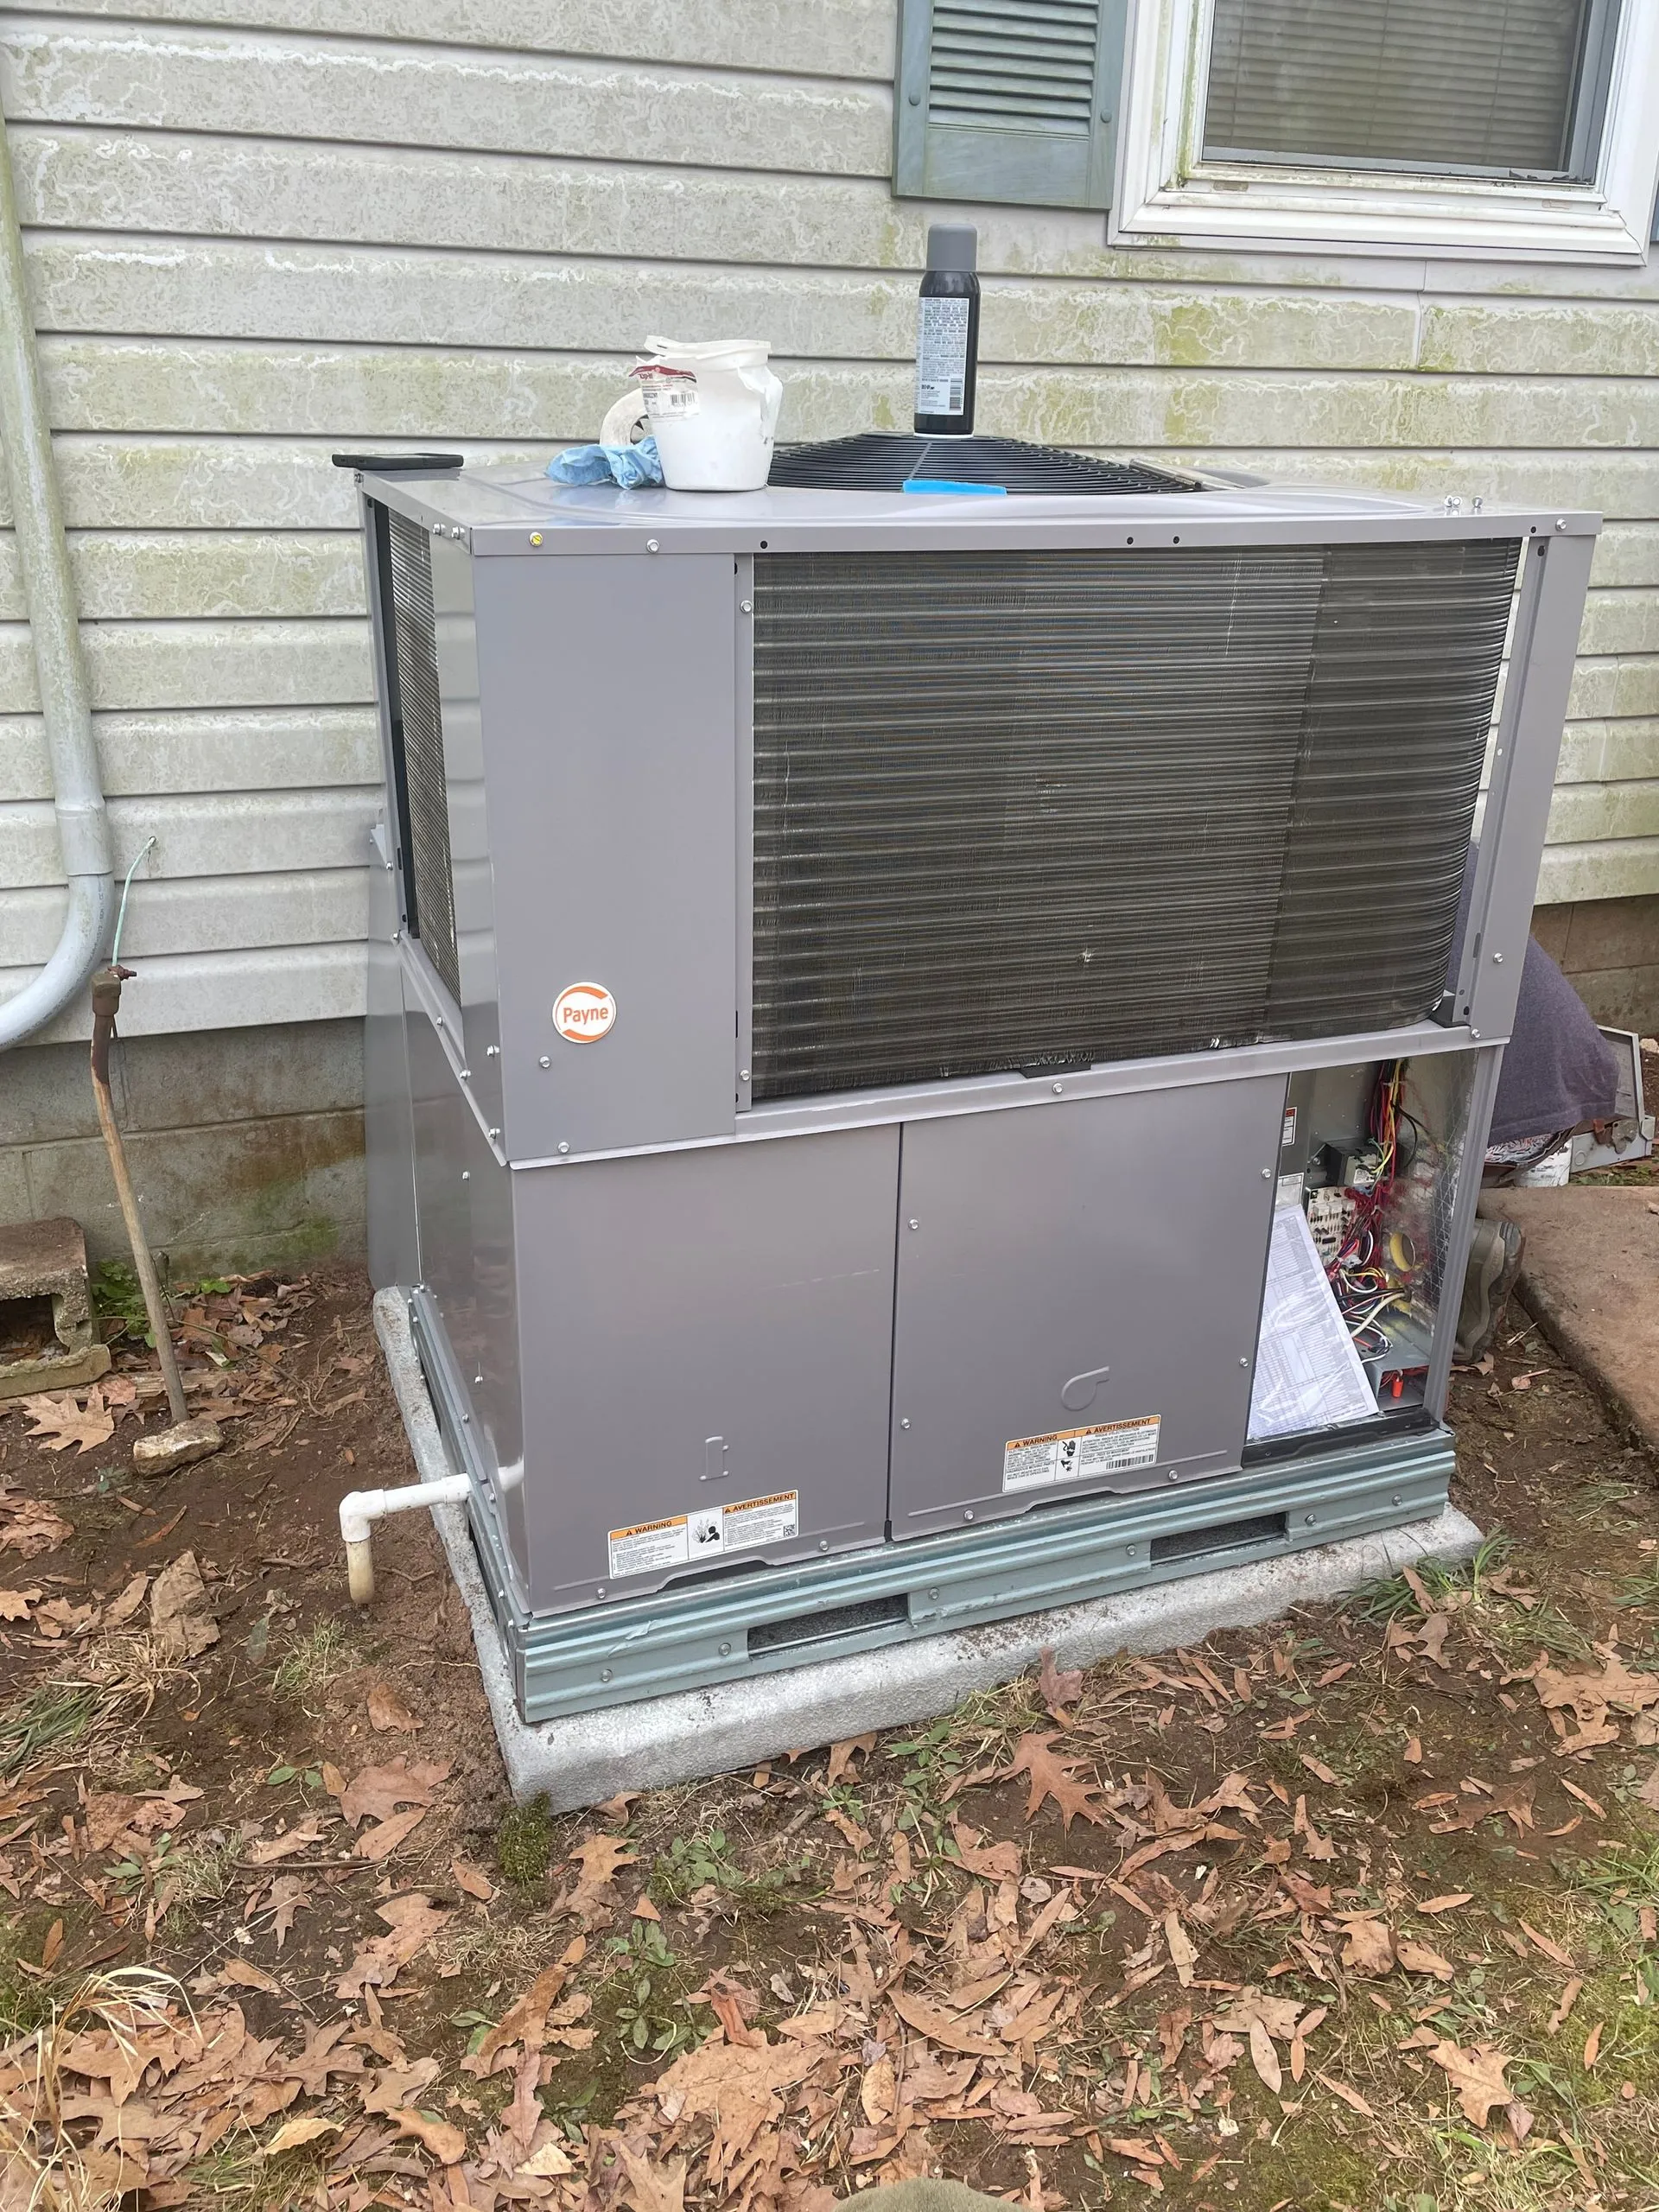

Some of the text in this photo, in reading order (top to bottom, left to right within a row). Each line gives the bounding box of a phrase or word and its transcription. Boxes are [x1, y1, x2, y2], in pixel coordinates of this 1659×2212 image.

[563, 1007, 609, 1026] Payne
[1093, 1418, 1151, 1433] AVERTISSEMENT
[1022, 1434, 1058, 1446] WARNING
[733, 1493, 795, 1512] AVERTISSEMENT
[634, 1520, 672, 1535] WARNING
